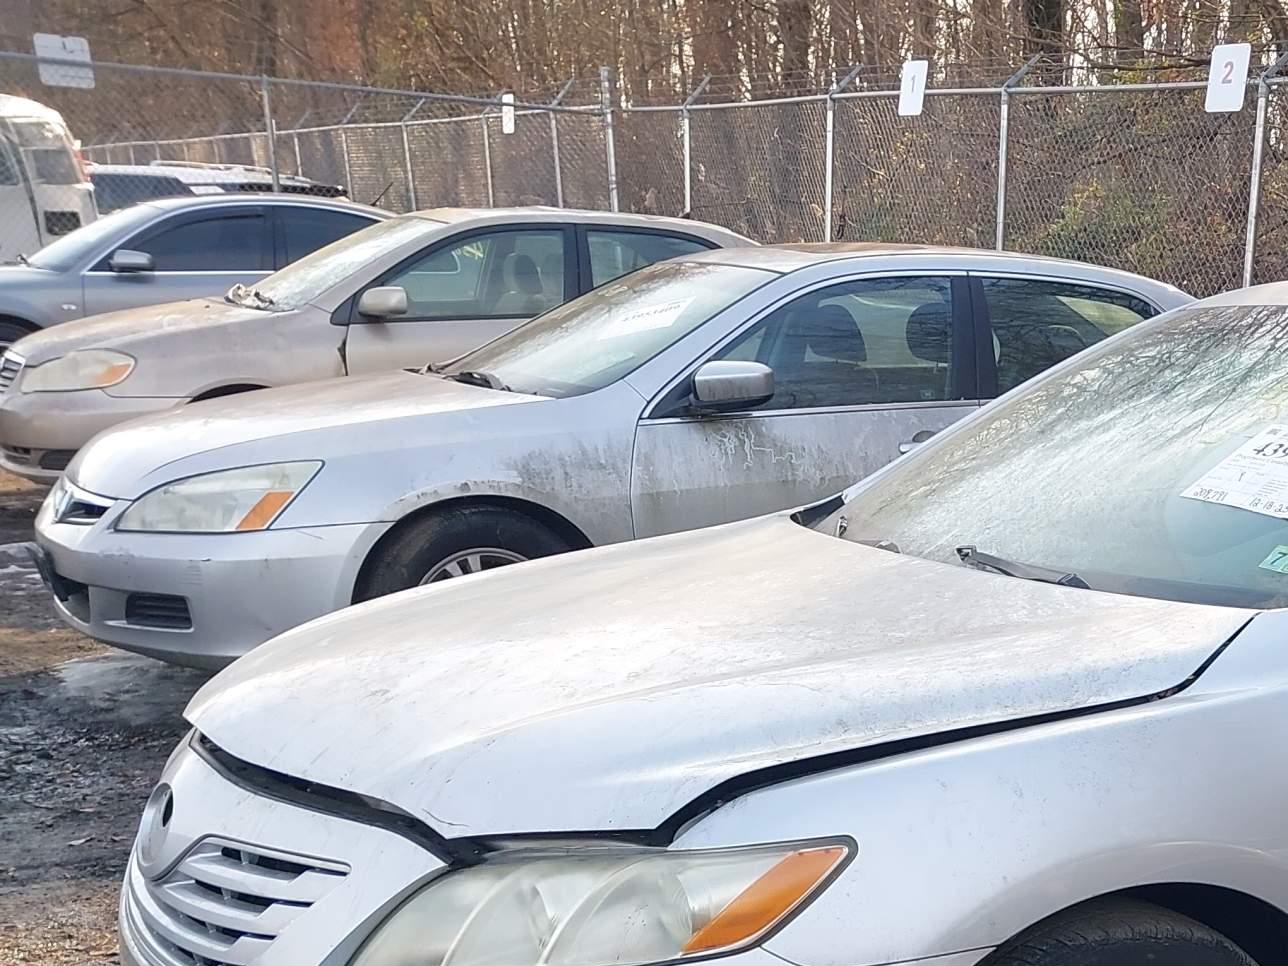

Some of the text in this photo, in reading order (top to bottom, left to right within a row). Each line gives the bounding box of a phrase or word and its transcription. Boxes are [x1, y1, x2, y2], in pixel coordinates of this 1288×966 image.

[1221, 60, 1234, 84] 2
[910, 74, 917, 94] 1
[1270, 551, 1288, 565] 7
